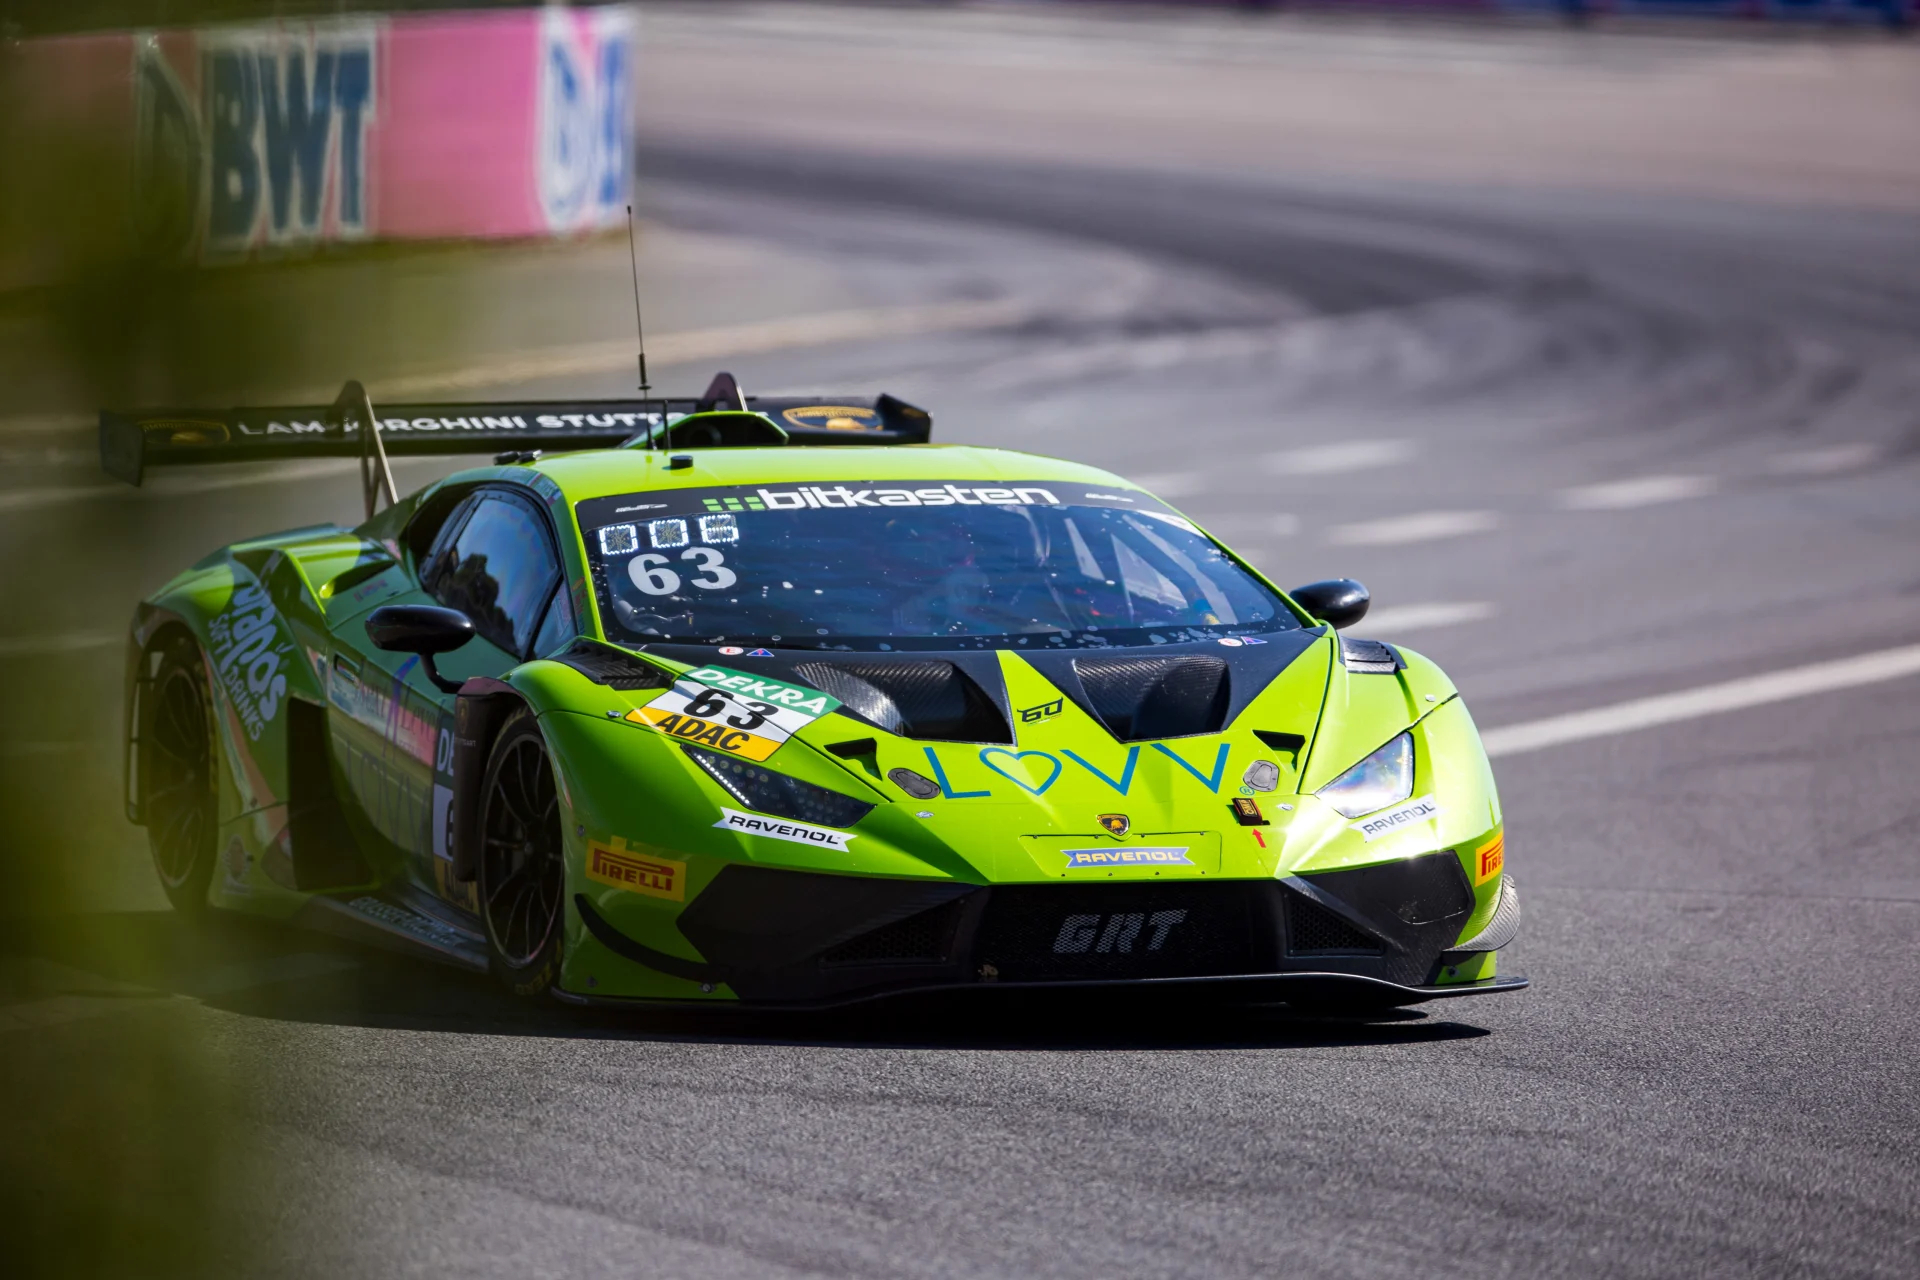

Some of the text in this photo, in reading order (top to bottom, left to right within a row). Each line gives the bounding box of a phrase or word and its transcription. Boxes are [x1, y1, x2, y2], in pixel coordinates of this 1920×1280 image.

[207, 44, 374, 240] BWT
[238, 416, 528, 435] LAMRGHINI
[757, 484, 1060, 510] bitkasten
[627, 546, 738, 596] 63
[208, 613, 265, 742] SOFT DRINKS
[688, 668, 828, 715] DEKRA
[683, 688, 780, 731] 63
[655, 714, 751, 751] ADAC
[728, 815, 840, 845] RAVENOL
[1362, 802, 1436, 835] RAVENOL
[593, 848, 675, 892] PIRELLI
[1075, 851, 1181, 864] RAVENOL
[1053, 908, 1189, 954] GRT
